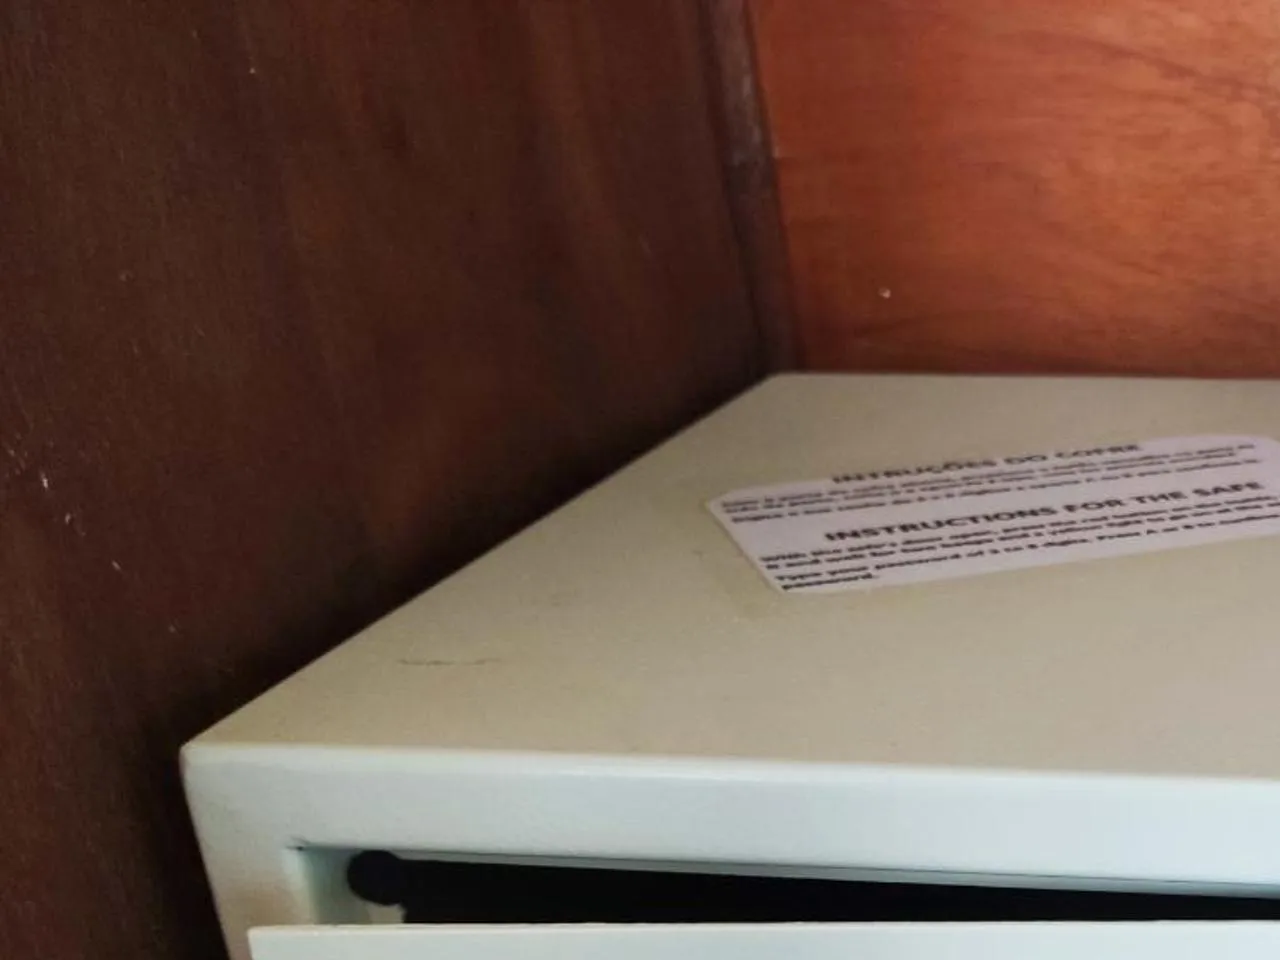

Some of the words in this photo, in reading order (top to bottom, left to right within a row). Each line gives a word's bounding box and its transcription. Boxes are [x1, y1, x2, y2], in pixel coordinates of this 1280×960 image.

[824, 506, 1058, 542] INSTRUCTIONS
[1064, 499, 1126, 514] FOR
[1132, 490, 1187, 505] THE
[1192, 481, 1264, 497] SAFE
